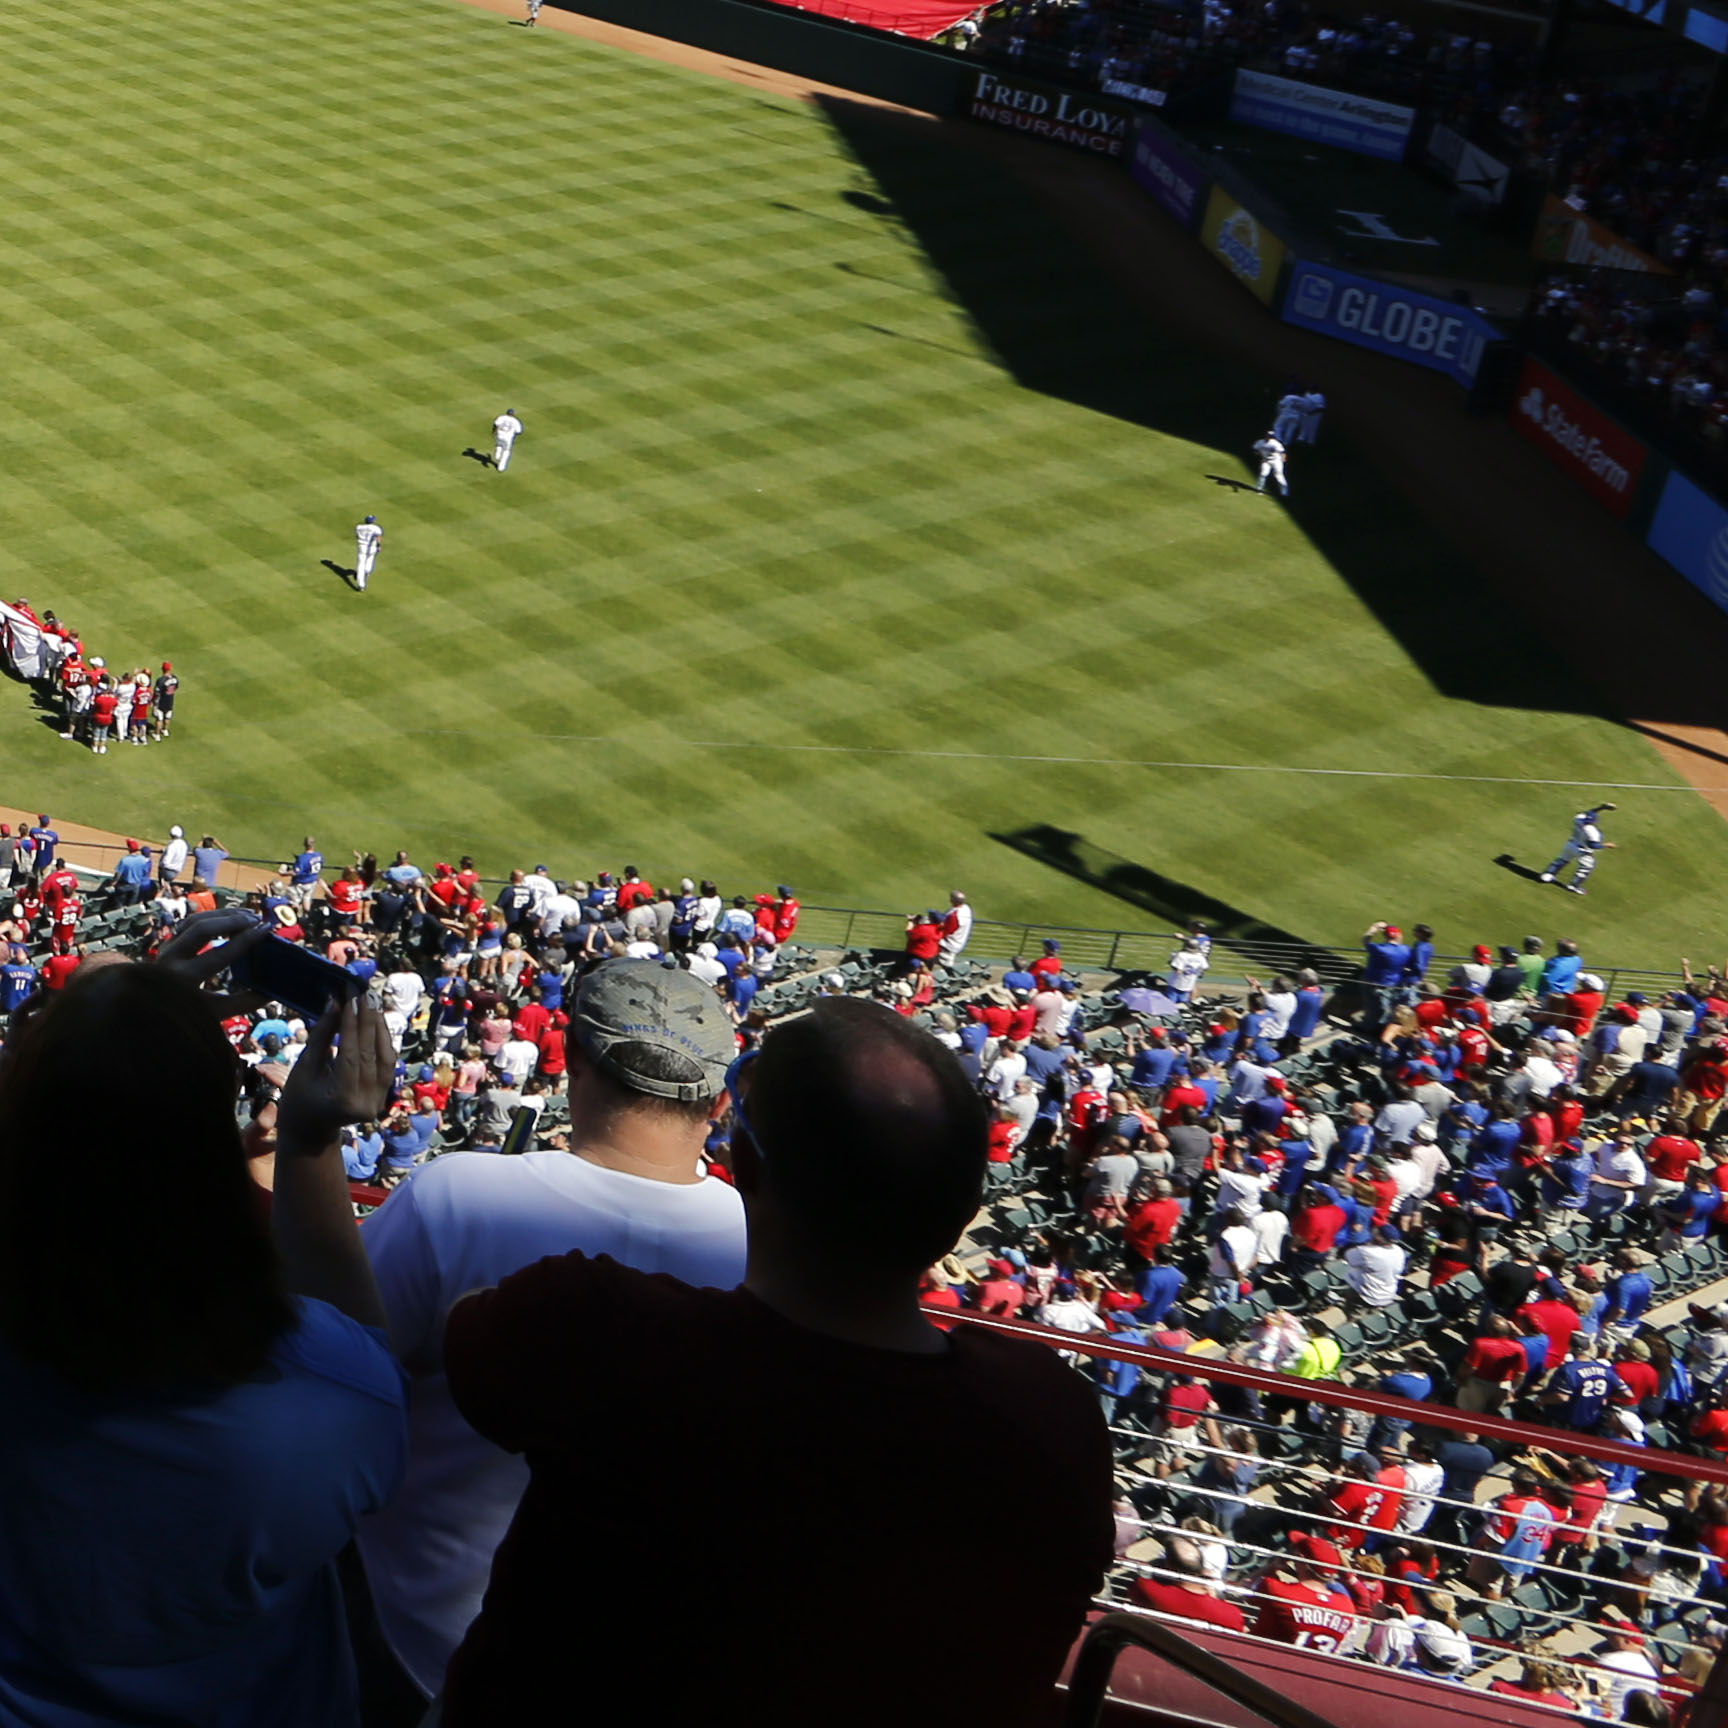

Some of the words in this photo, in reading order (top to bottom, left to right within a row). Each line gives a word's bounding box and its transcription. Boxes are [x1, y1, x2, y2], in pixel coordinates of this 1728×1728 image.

[975, 73, 1048, 115] FRED
[1055, 93, 1127, 138] LOYA
[971, 102, 1125, 157] INSURANCE
[1336, 287, 1464, 360] GLOBE
[61, 913, 77, 925] 29
[15, 979, 26, 991] 11
[1581, 1379, 1608, 1398] 29
[1292, 1607, 1353, 1634] PROFAR
